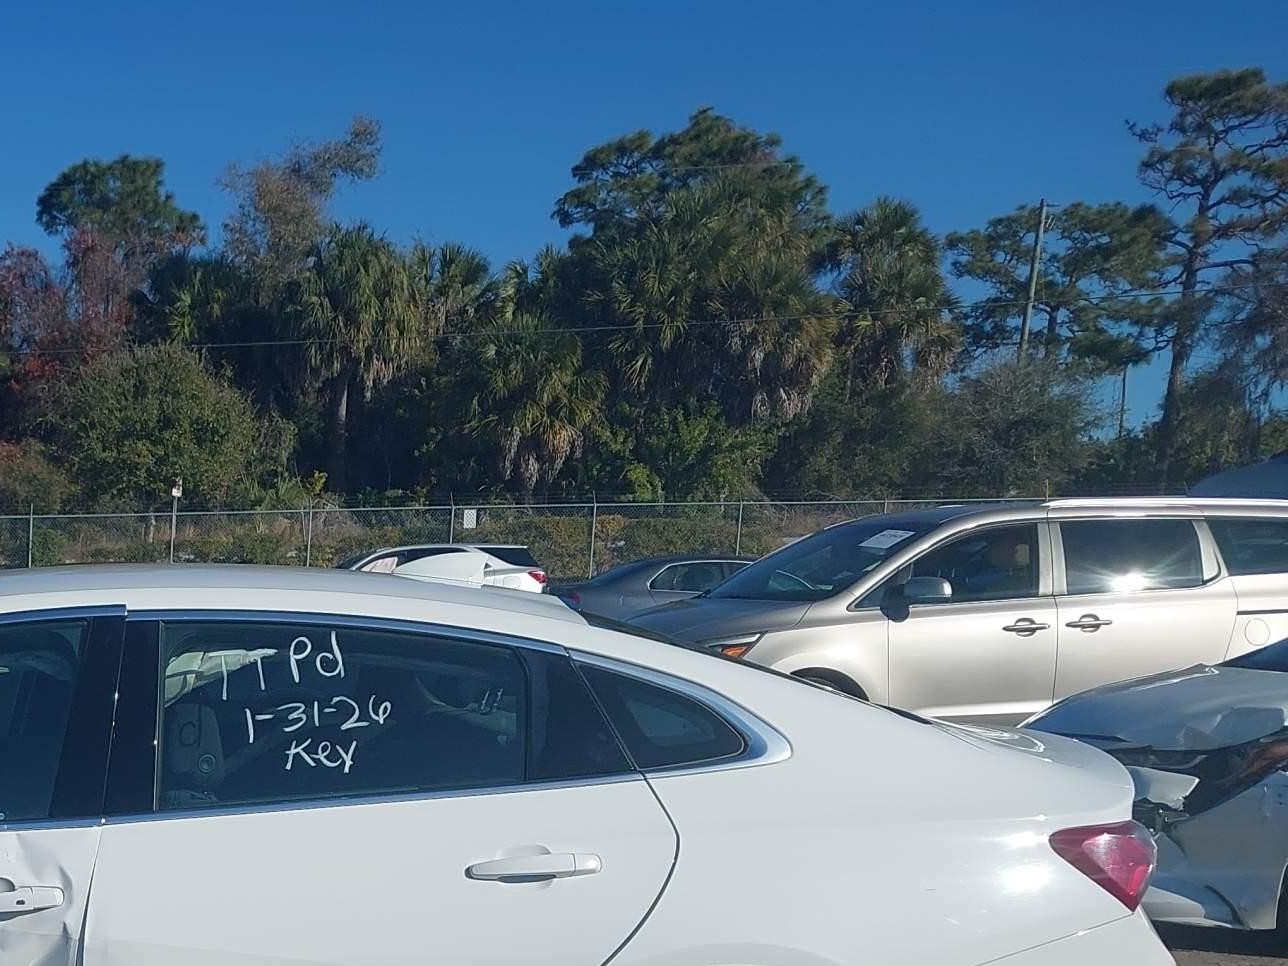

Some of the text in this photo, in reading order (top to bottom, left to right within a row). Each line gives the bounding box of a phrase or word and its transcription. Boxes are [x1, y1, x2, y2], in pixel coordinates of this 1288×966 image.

[289, 630, 345, 684] Pd
[244, 694, 392, 743] 1-31-26
[284, 737, 358, 774] Key
